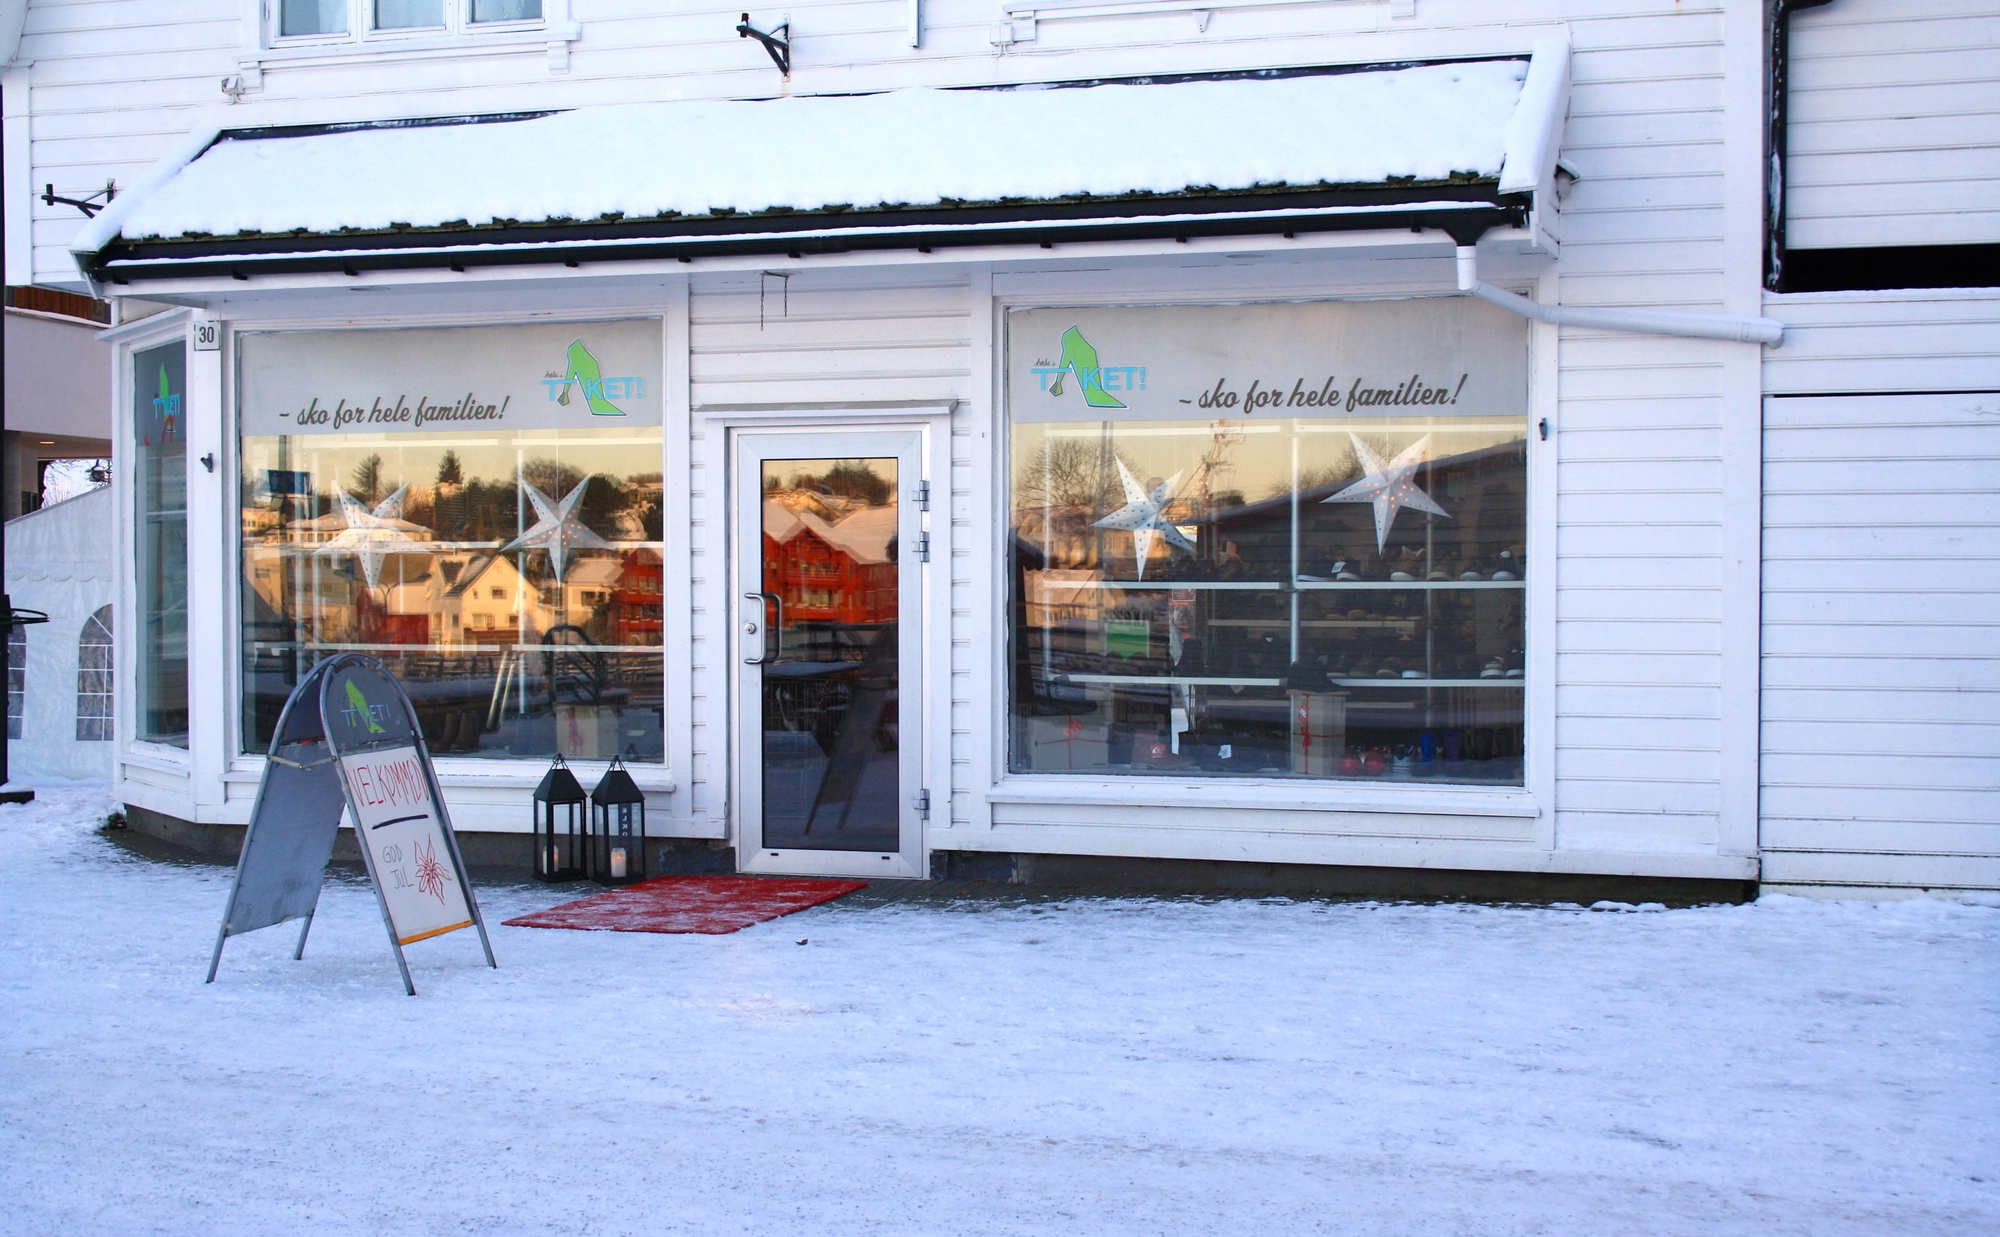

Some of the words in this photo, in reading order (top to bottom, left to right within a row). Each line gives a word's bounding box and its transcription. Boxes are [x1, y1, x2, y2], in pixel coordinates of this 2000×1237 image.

[199, 326, 215, 344] 30
[1198, 377, 1241, 409] sko
[1243, 379, 1284, 414] for
[1286, 375, 1342, 408] hele
[1345, 373, 1469, 413] familien!
[296, 397, 330, 426] sko
[333, 398, 366, 430] for
[367, 394, 412, 423] hele
[414, 392, 511, 428] familien!
[346, 754, 430, 806] VELKOMMEN
[382, 844, 403, 863] GOD
[391, 866, 414, 889] JUL
